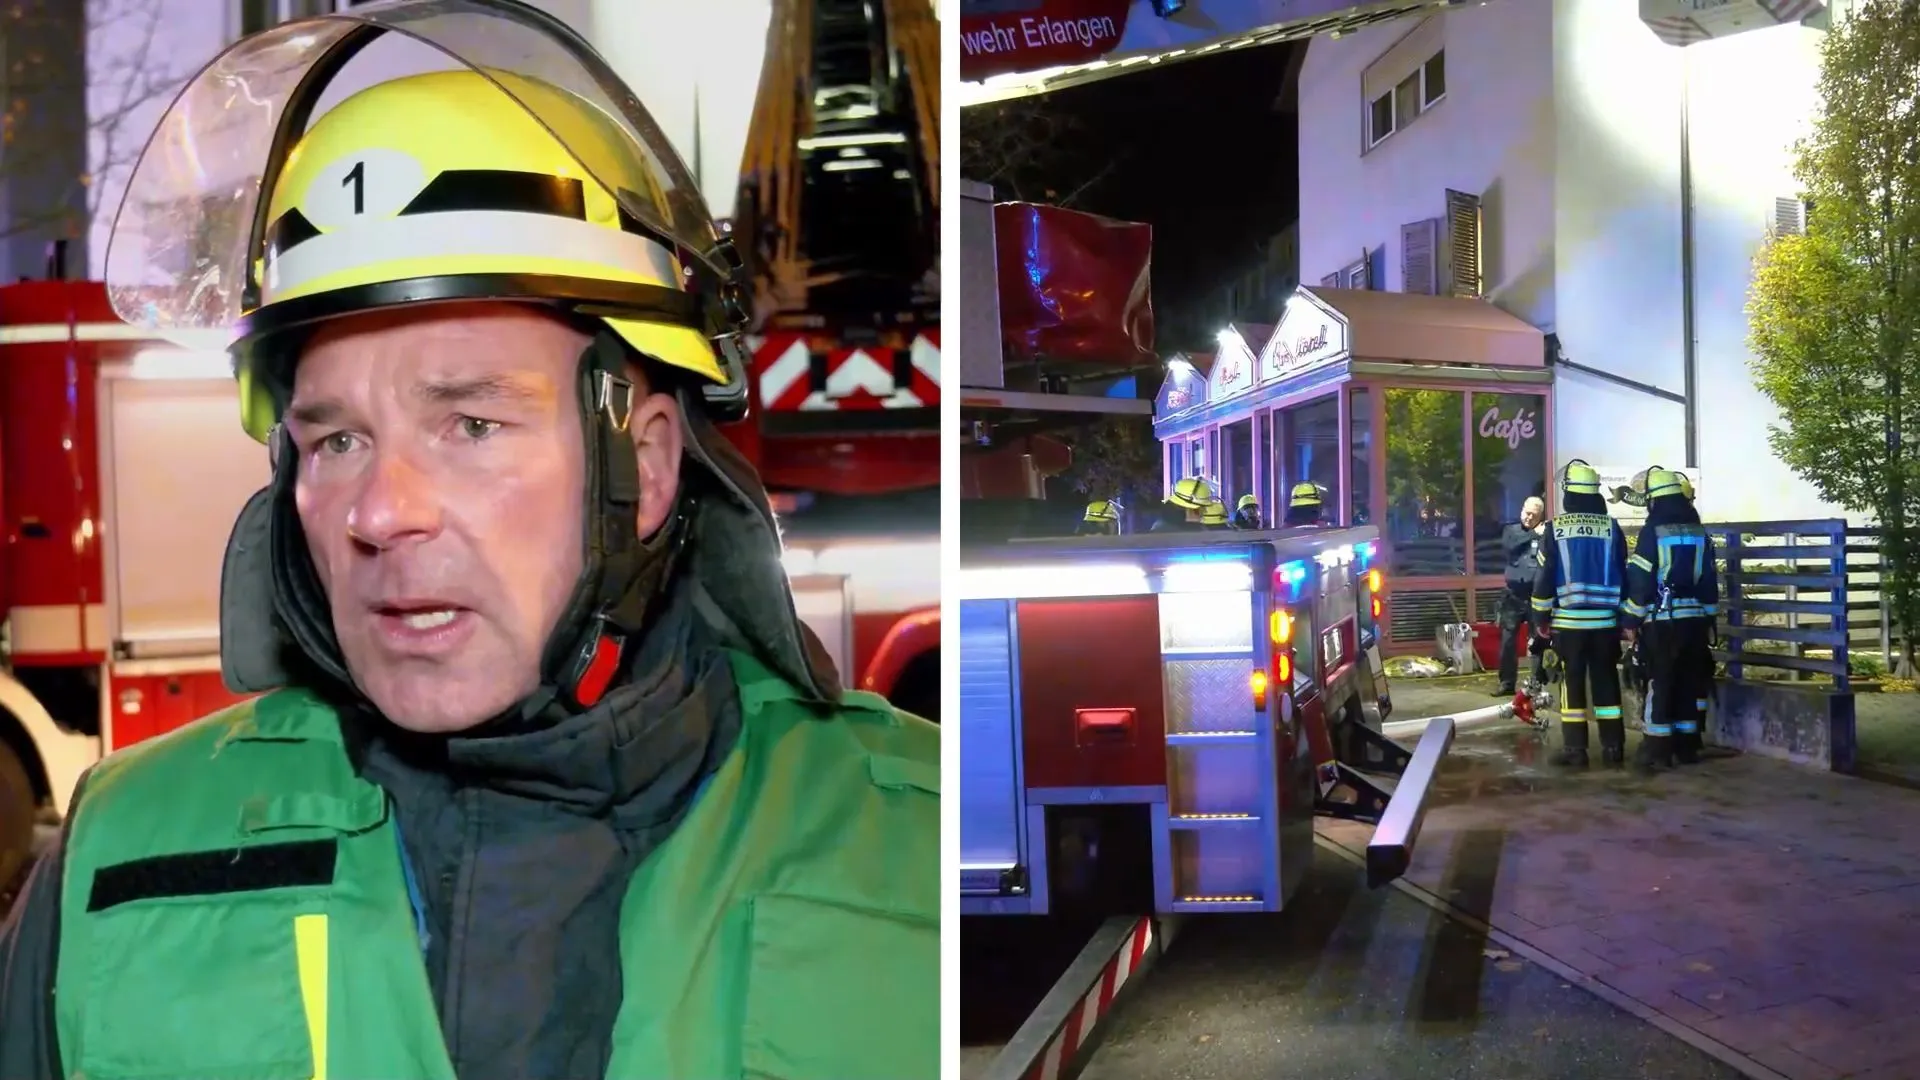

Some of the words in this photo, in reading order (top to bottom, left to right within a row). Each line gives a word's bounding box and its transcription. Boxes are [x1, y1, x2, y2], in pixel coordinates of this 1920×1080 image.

[960, 22, 1017, 55] wehr
[1020, 16, 1117, 48] Erlangen
[341, 160, 364, 215] 1
[1478, 406, 1537, 450] Café
